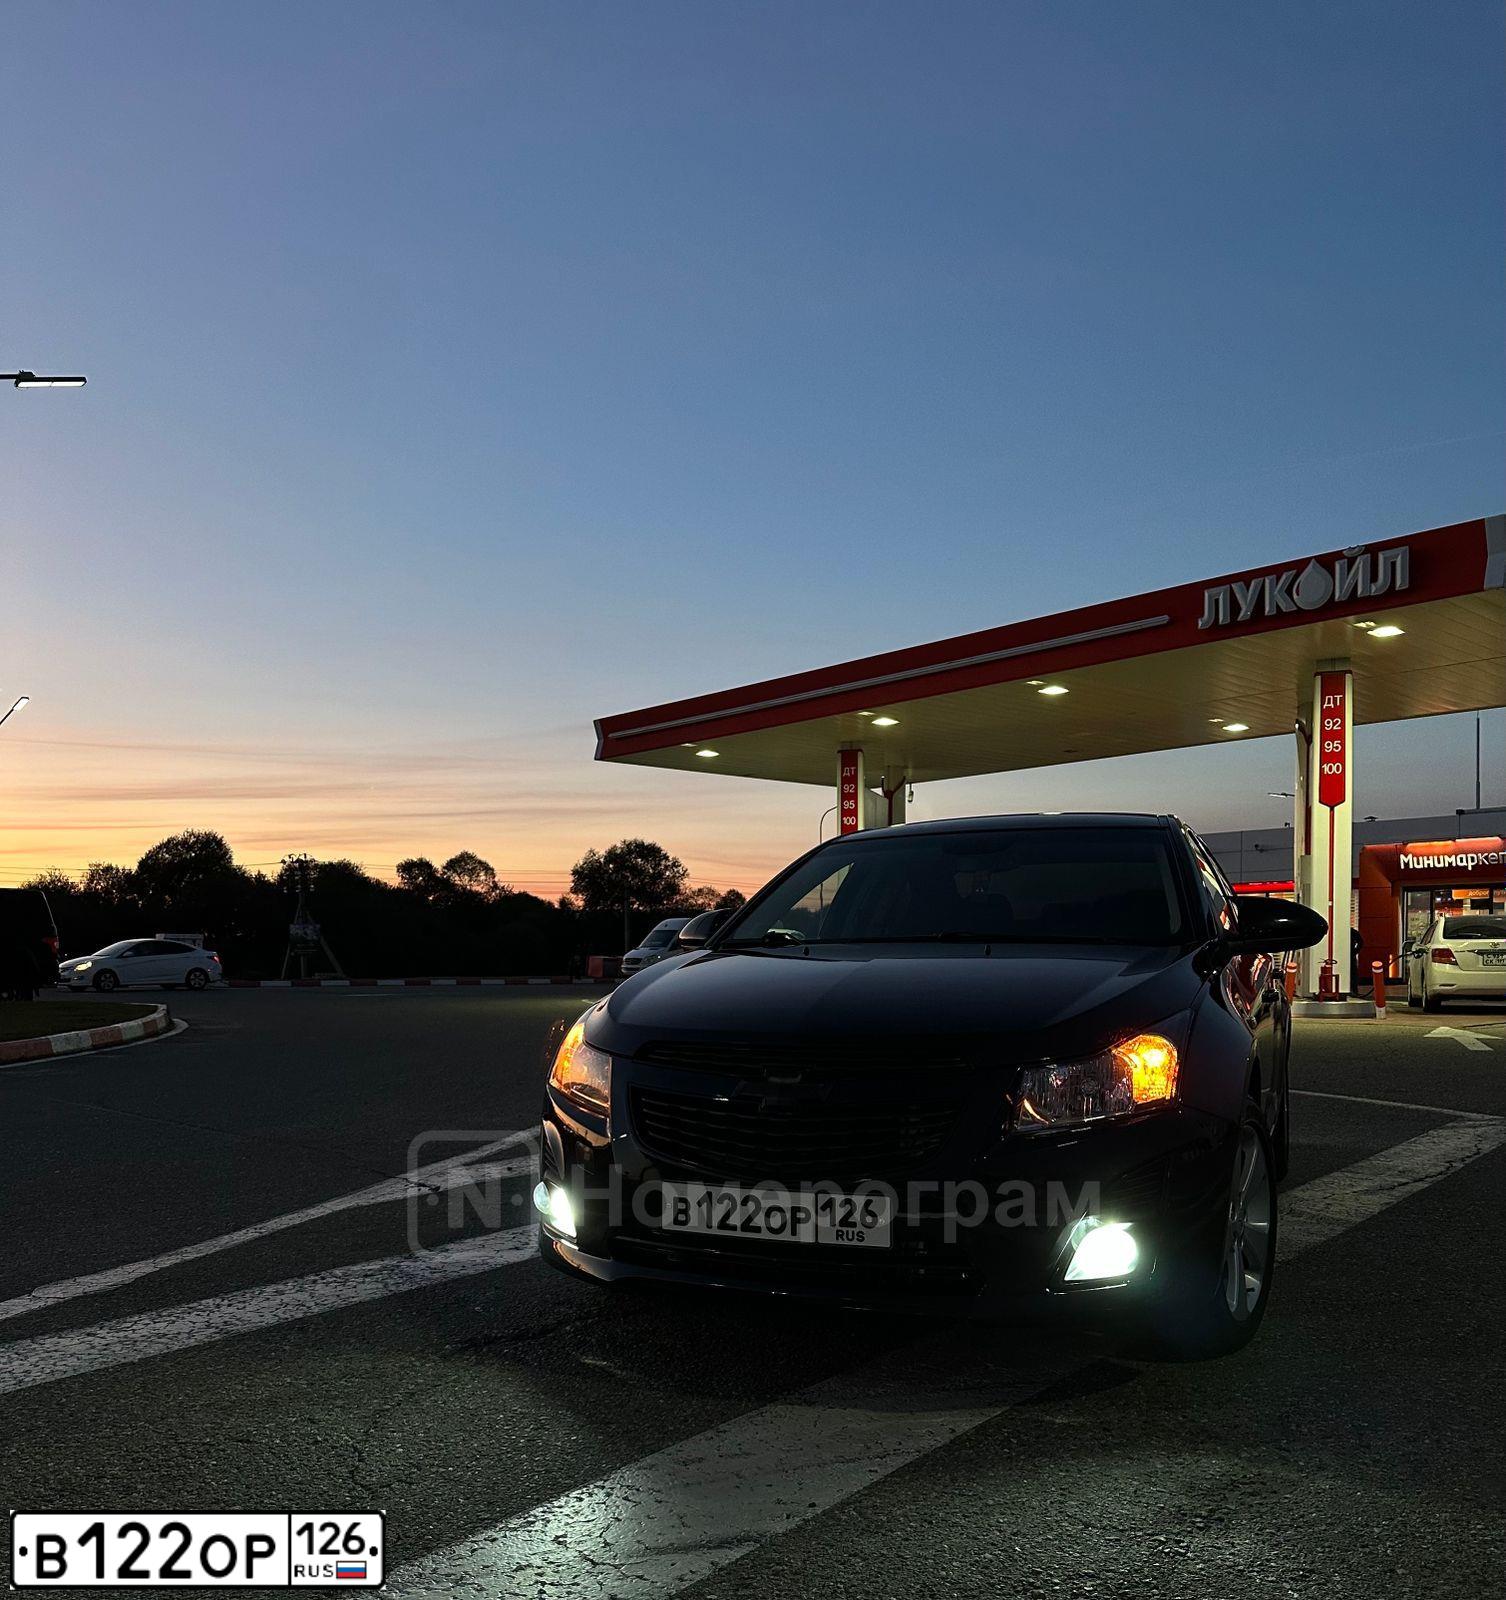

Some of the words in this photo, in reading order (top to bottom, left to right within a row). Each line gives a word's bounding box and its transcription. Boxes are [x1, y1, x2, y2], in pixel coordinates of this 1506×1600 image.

[1323, 695, 1343, 709] ДТ
[1324, 718, 1342, 731] 92
[1324, 740, 1342, 753] 95
[843, 767, 856, 776] ДТ
[1321, 762, 1343, 775] 100
[843, 784, 855, 793] 92
[843, 800, 855, 810] 95
[842, 816, 857, 826] 100
[672, 1190, 812, 1237] В122ОР
[819, 1197, 879, 1229] 126
[835, 1229, 866, 1243] RUS
